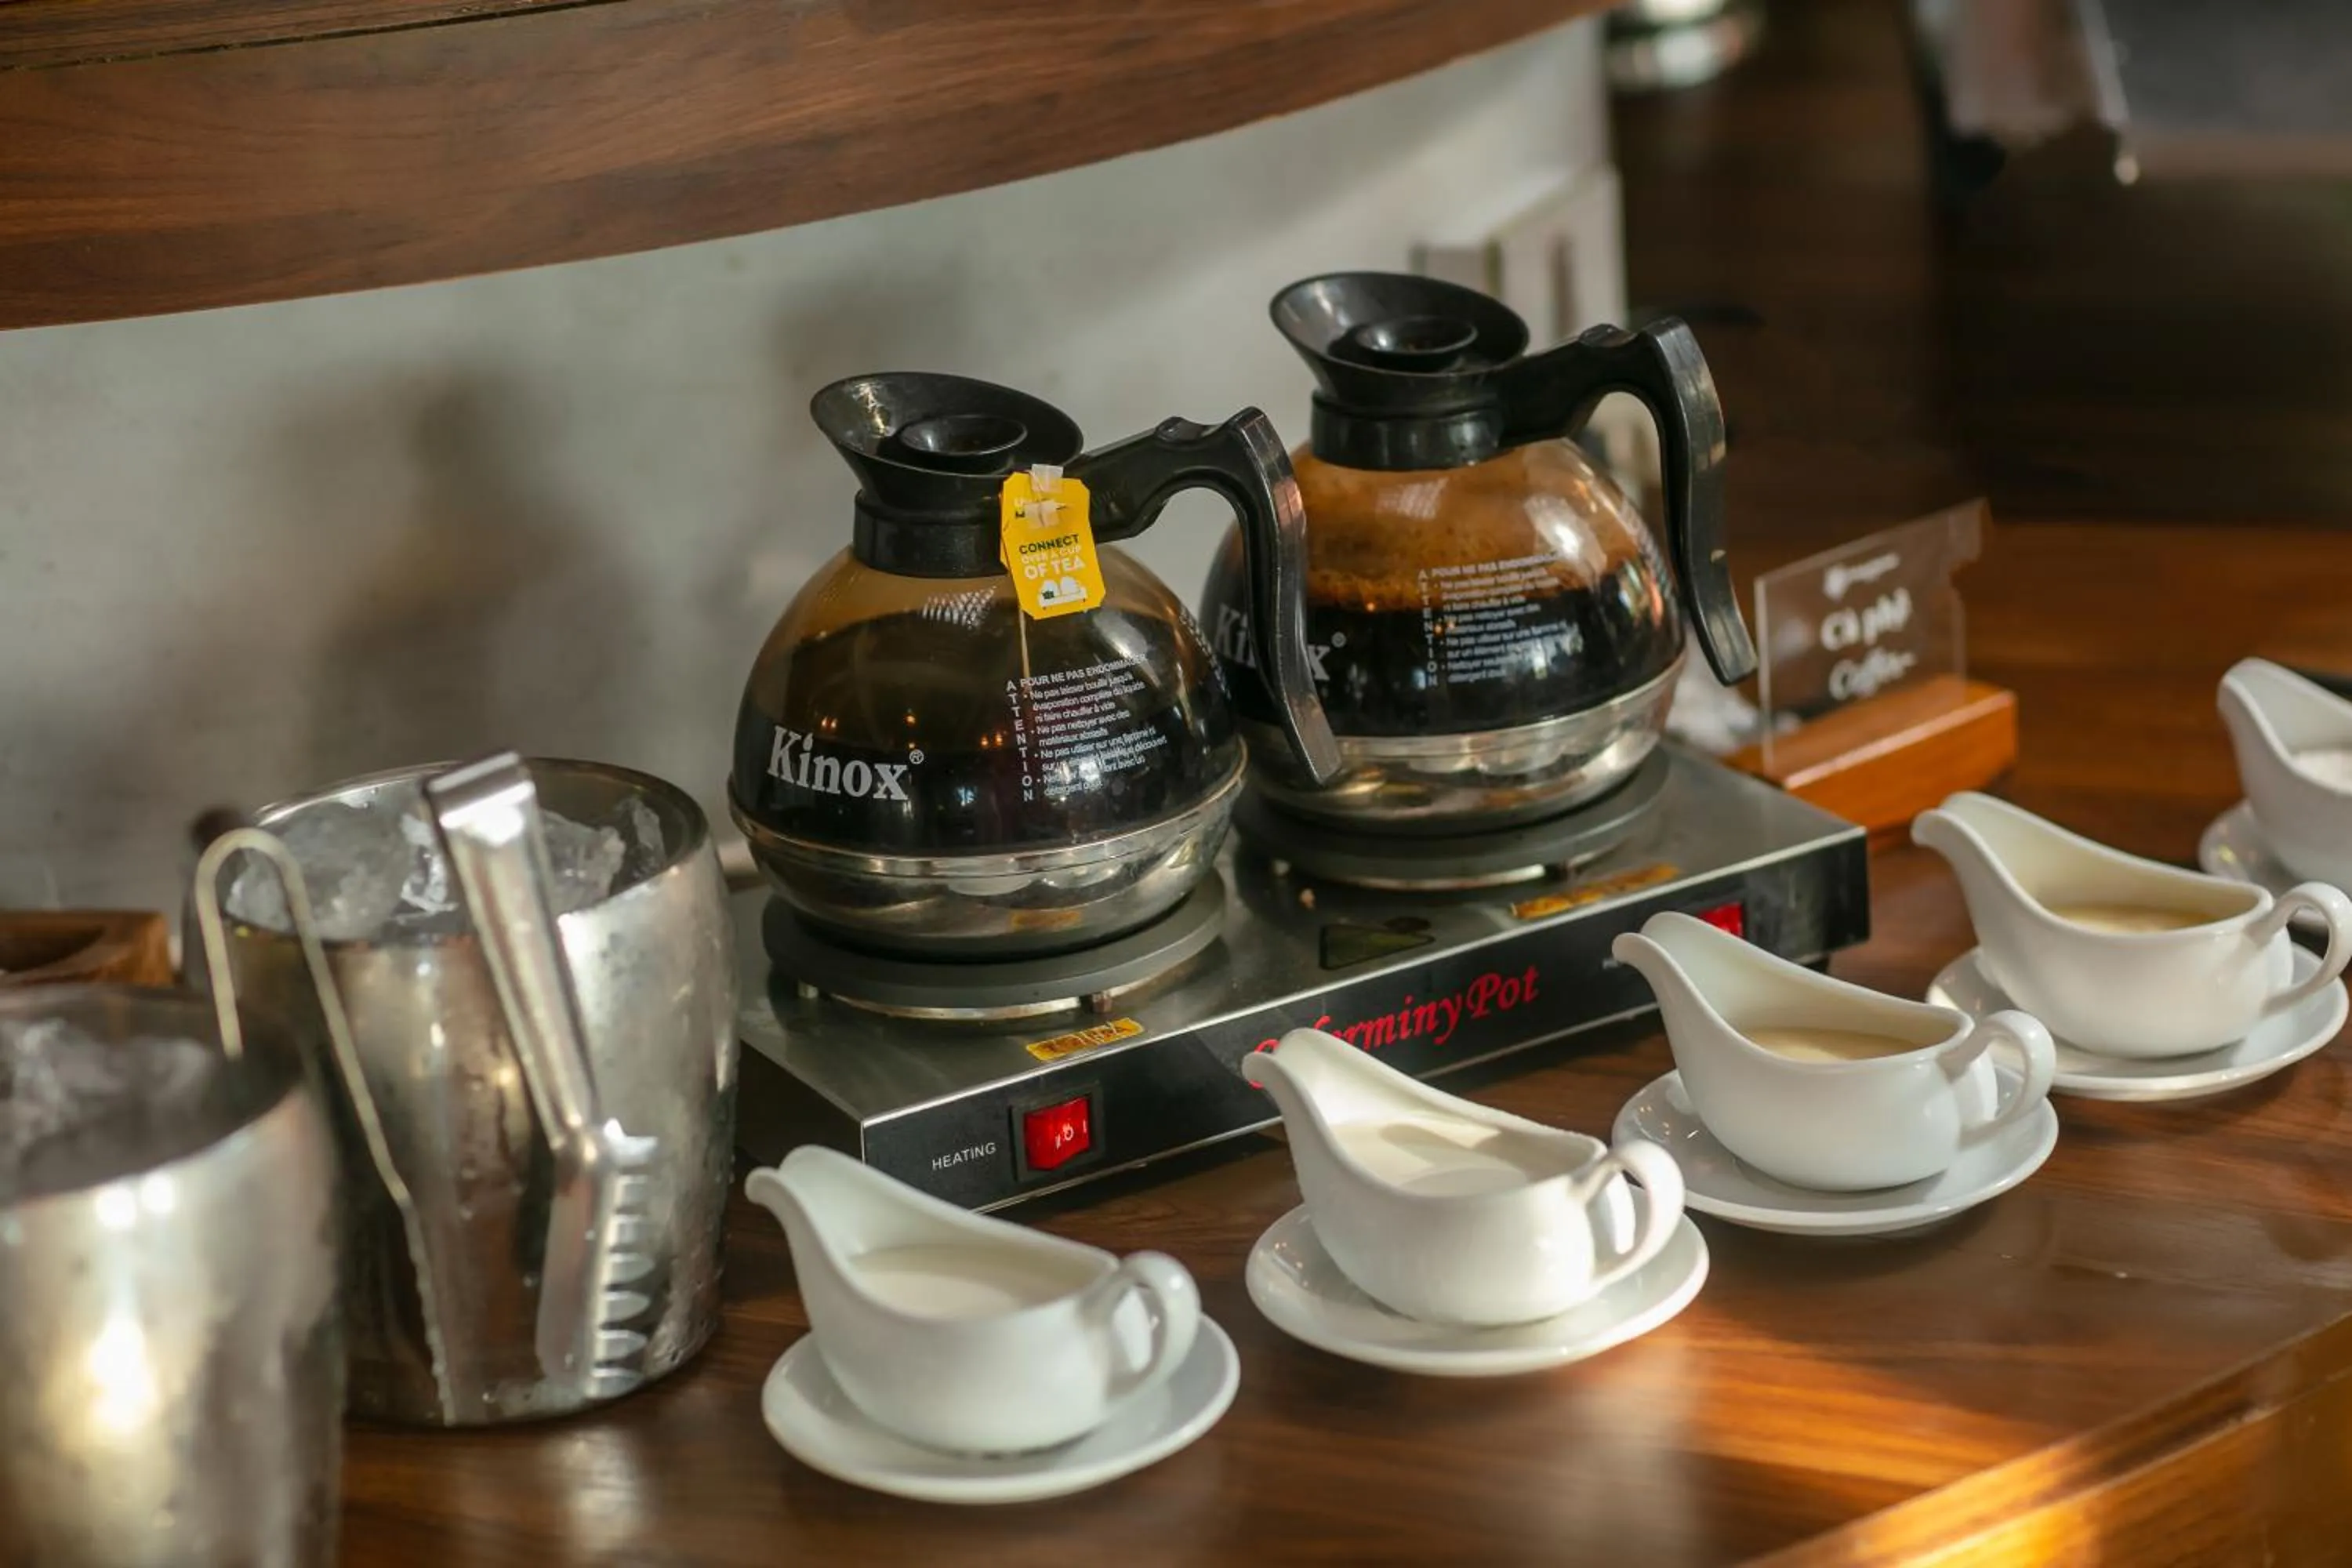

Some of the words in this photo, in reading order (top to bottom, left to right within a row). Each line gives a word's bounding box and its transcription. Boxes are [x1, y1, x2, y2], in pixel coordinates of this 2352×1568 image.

[1019, 534, 1079, 554] CONNECT
[1024, 564, 1047, 580] OF
[1051, 555, 1086, 575] TEA
[1020, 675, 1049, 688] POUR
[1051, 672, 1065, 682] NE
[1066, 669, 1085, 680] PAS
[932, 1142, 996, 1171] HEATING
